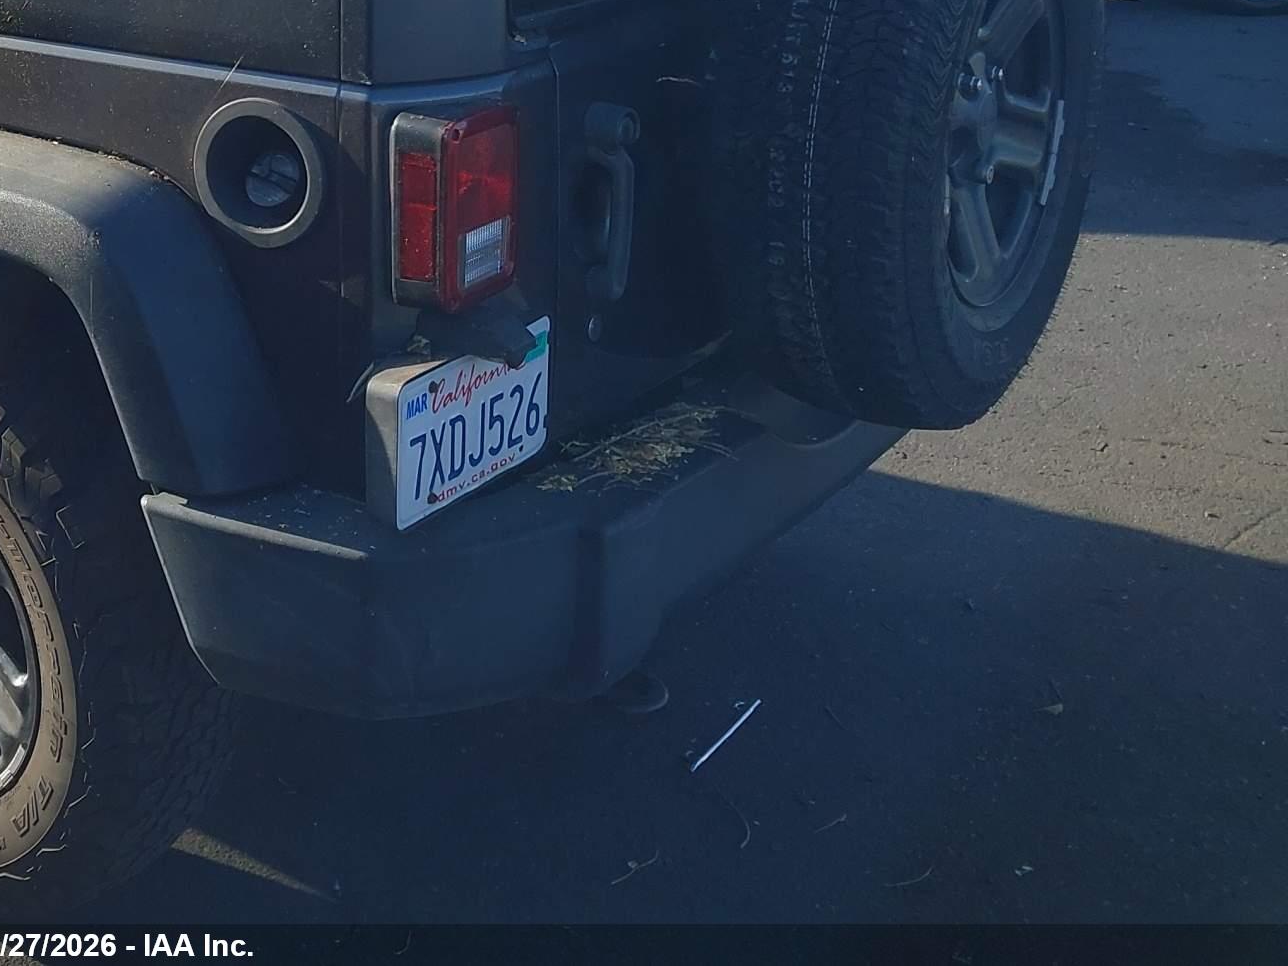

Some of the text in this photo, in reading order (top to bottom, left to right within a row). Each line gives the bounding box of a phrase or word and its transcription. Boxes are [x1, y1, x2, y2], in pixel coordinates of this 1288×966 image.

[406, 393, 428, 420] MAR
[409, 371, 542, 500] 7XDJ526
[437, 451, 516, 503] dmv.ca.gov
